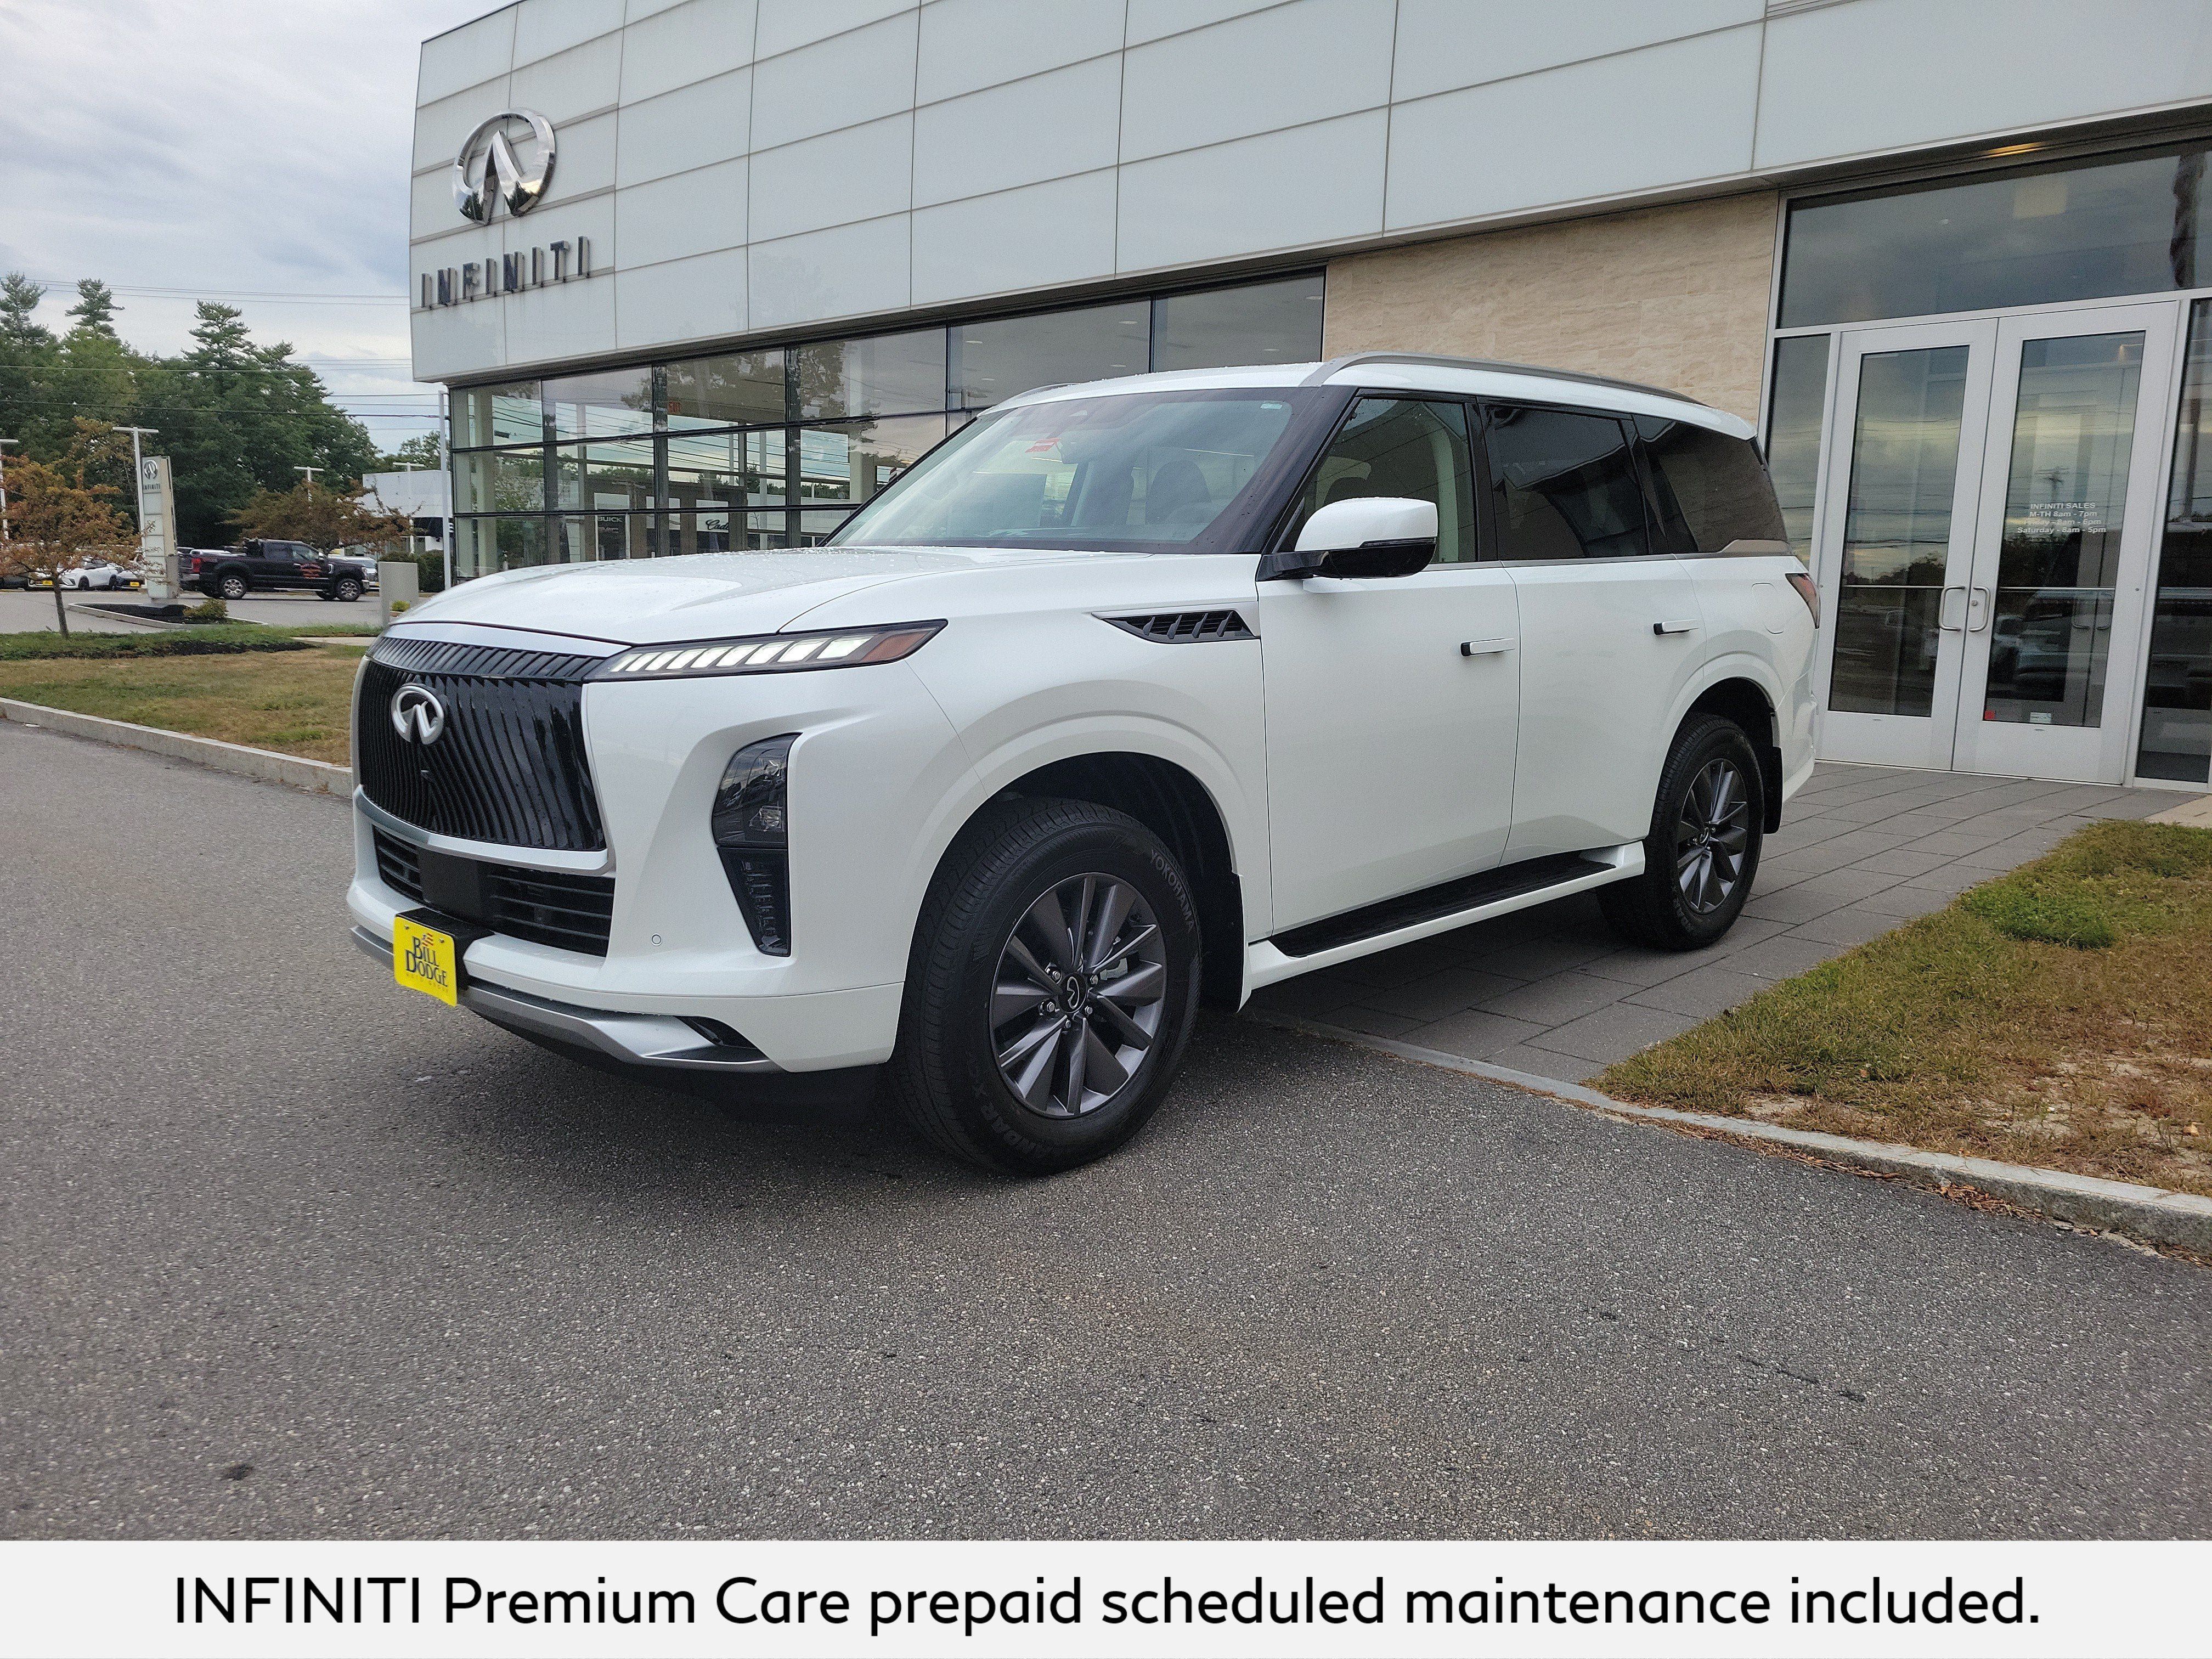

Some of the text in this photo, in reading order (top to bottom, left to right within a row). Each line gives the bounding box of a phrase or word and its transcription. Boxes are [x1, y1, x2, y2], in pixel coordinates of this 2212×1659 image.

[421, 235, 590, 309] INFINITI
[1150, 848, 1195, 934] YOKOHAMA
[405, 949, 448, 988] DODGE
[413, 935, 439, 967] BILL
